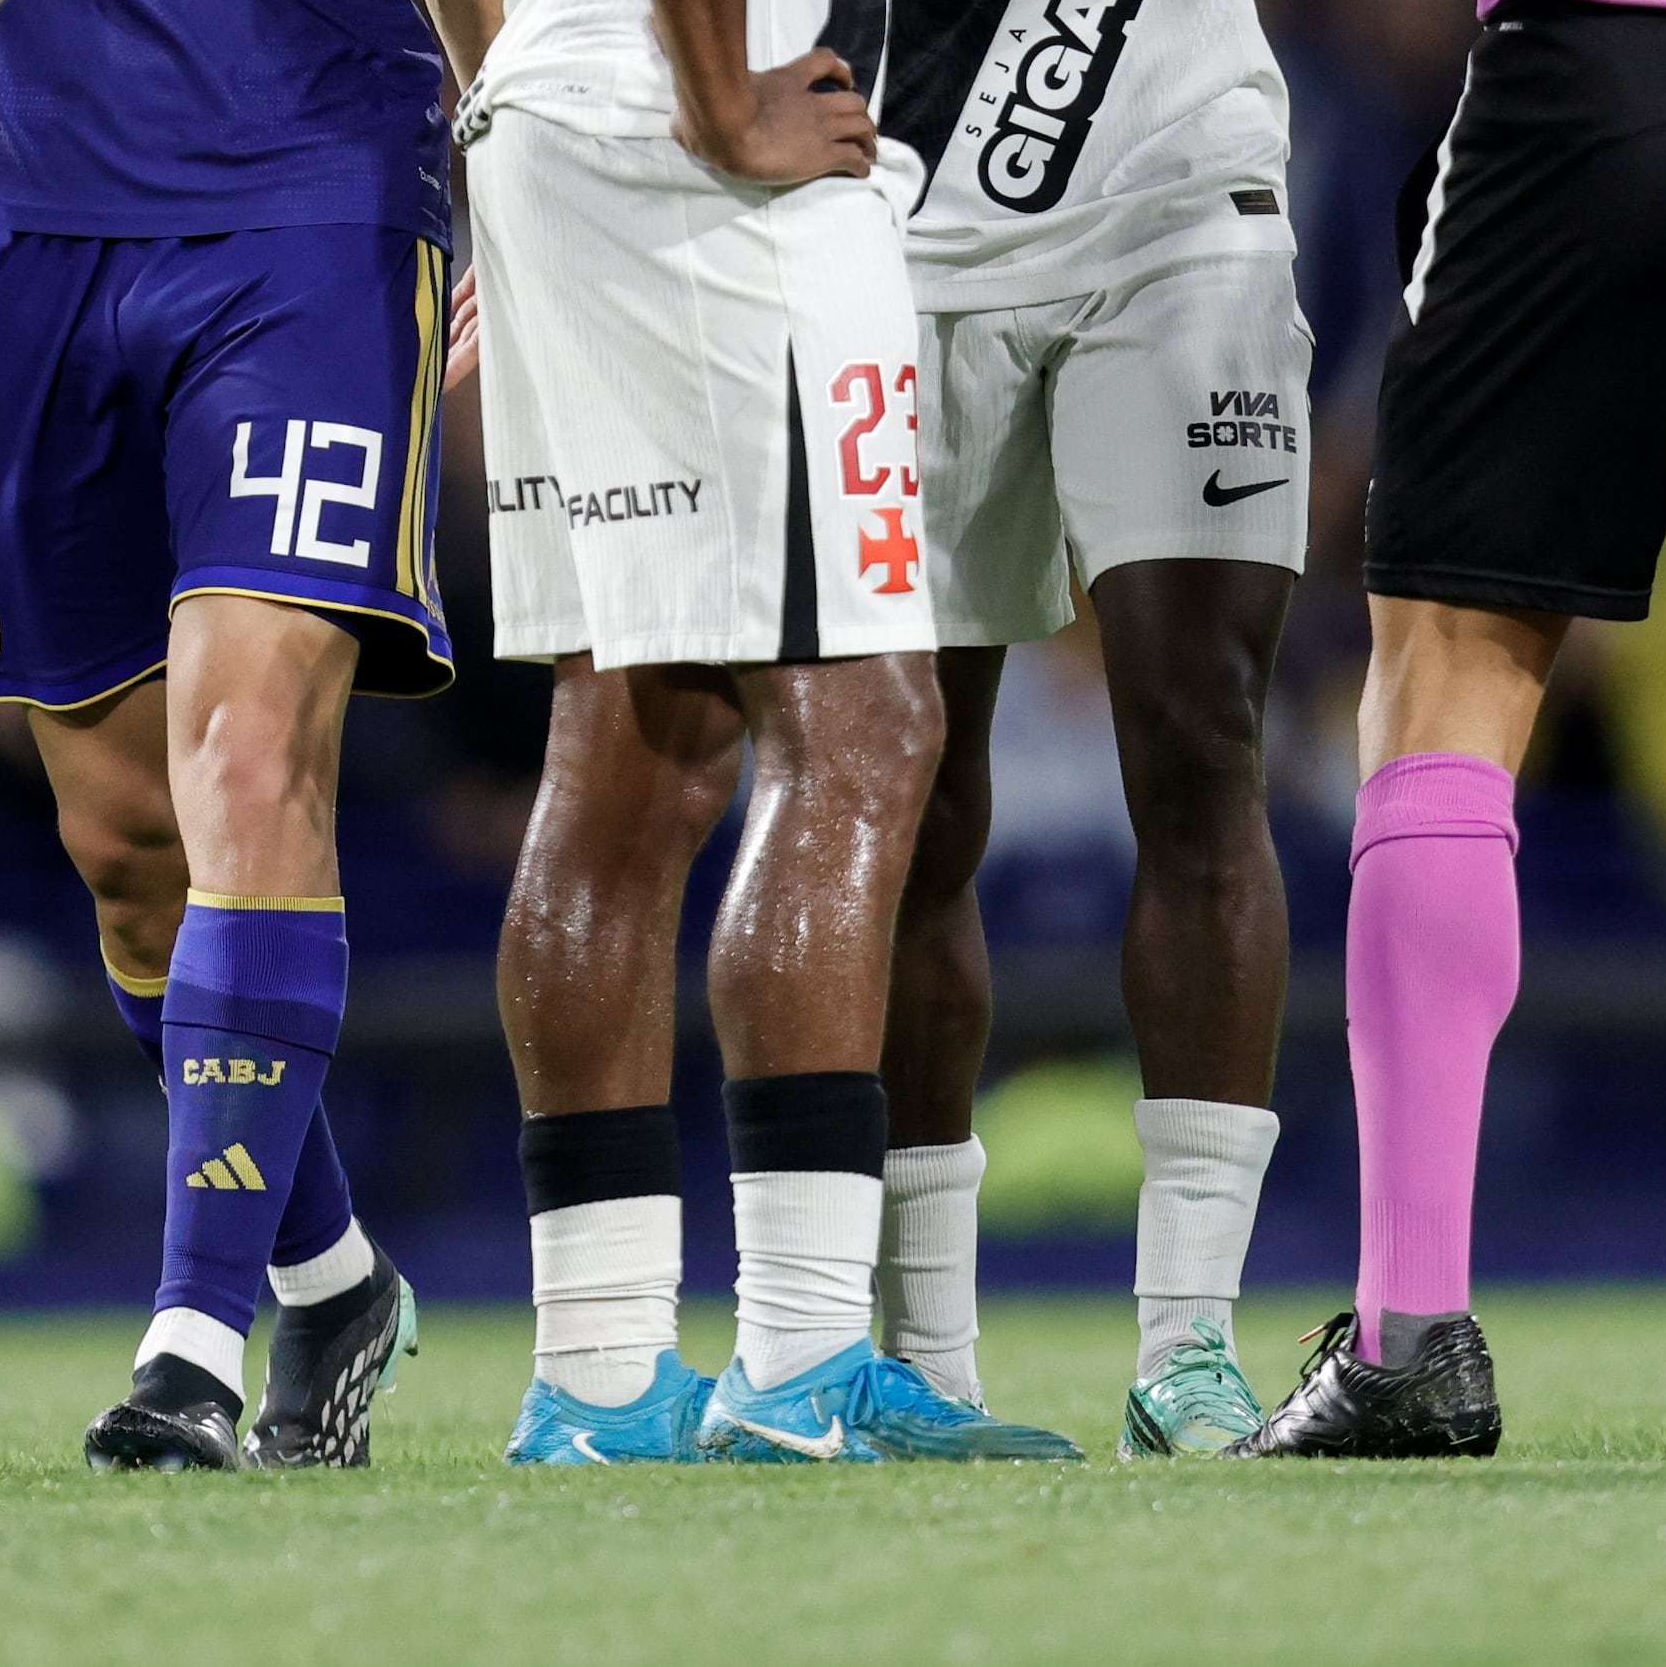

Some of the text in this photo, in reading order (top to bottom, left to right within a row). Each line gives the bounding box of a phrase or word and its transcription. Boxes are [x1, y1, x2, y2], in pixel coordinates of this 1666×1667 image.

[965, 27, 1028, 139] SEJA
[830, 363, 919, 496] 23
[1210, 391, 1279, 419] VIVA
[1187, 421, 1297, 454] SORTE
[229, 420, 383, 568] 42
[567, 478, 702, 530] FACILITY
[183, 1058, 287, 1086] CABJ
